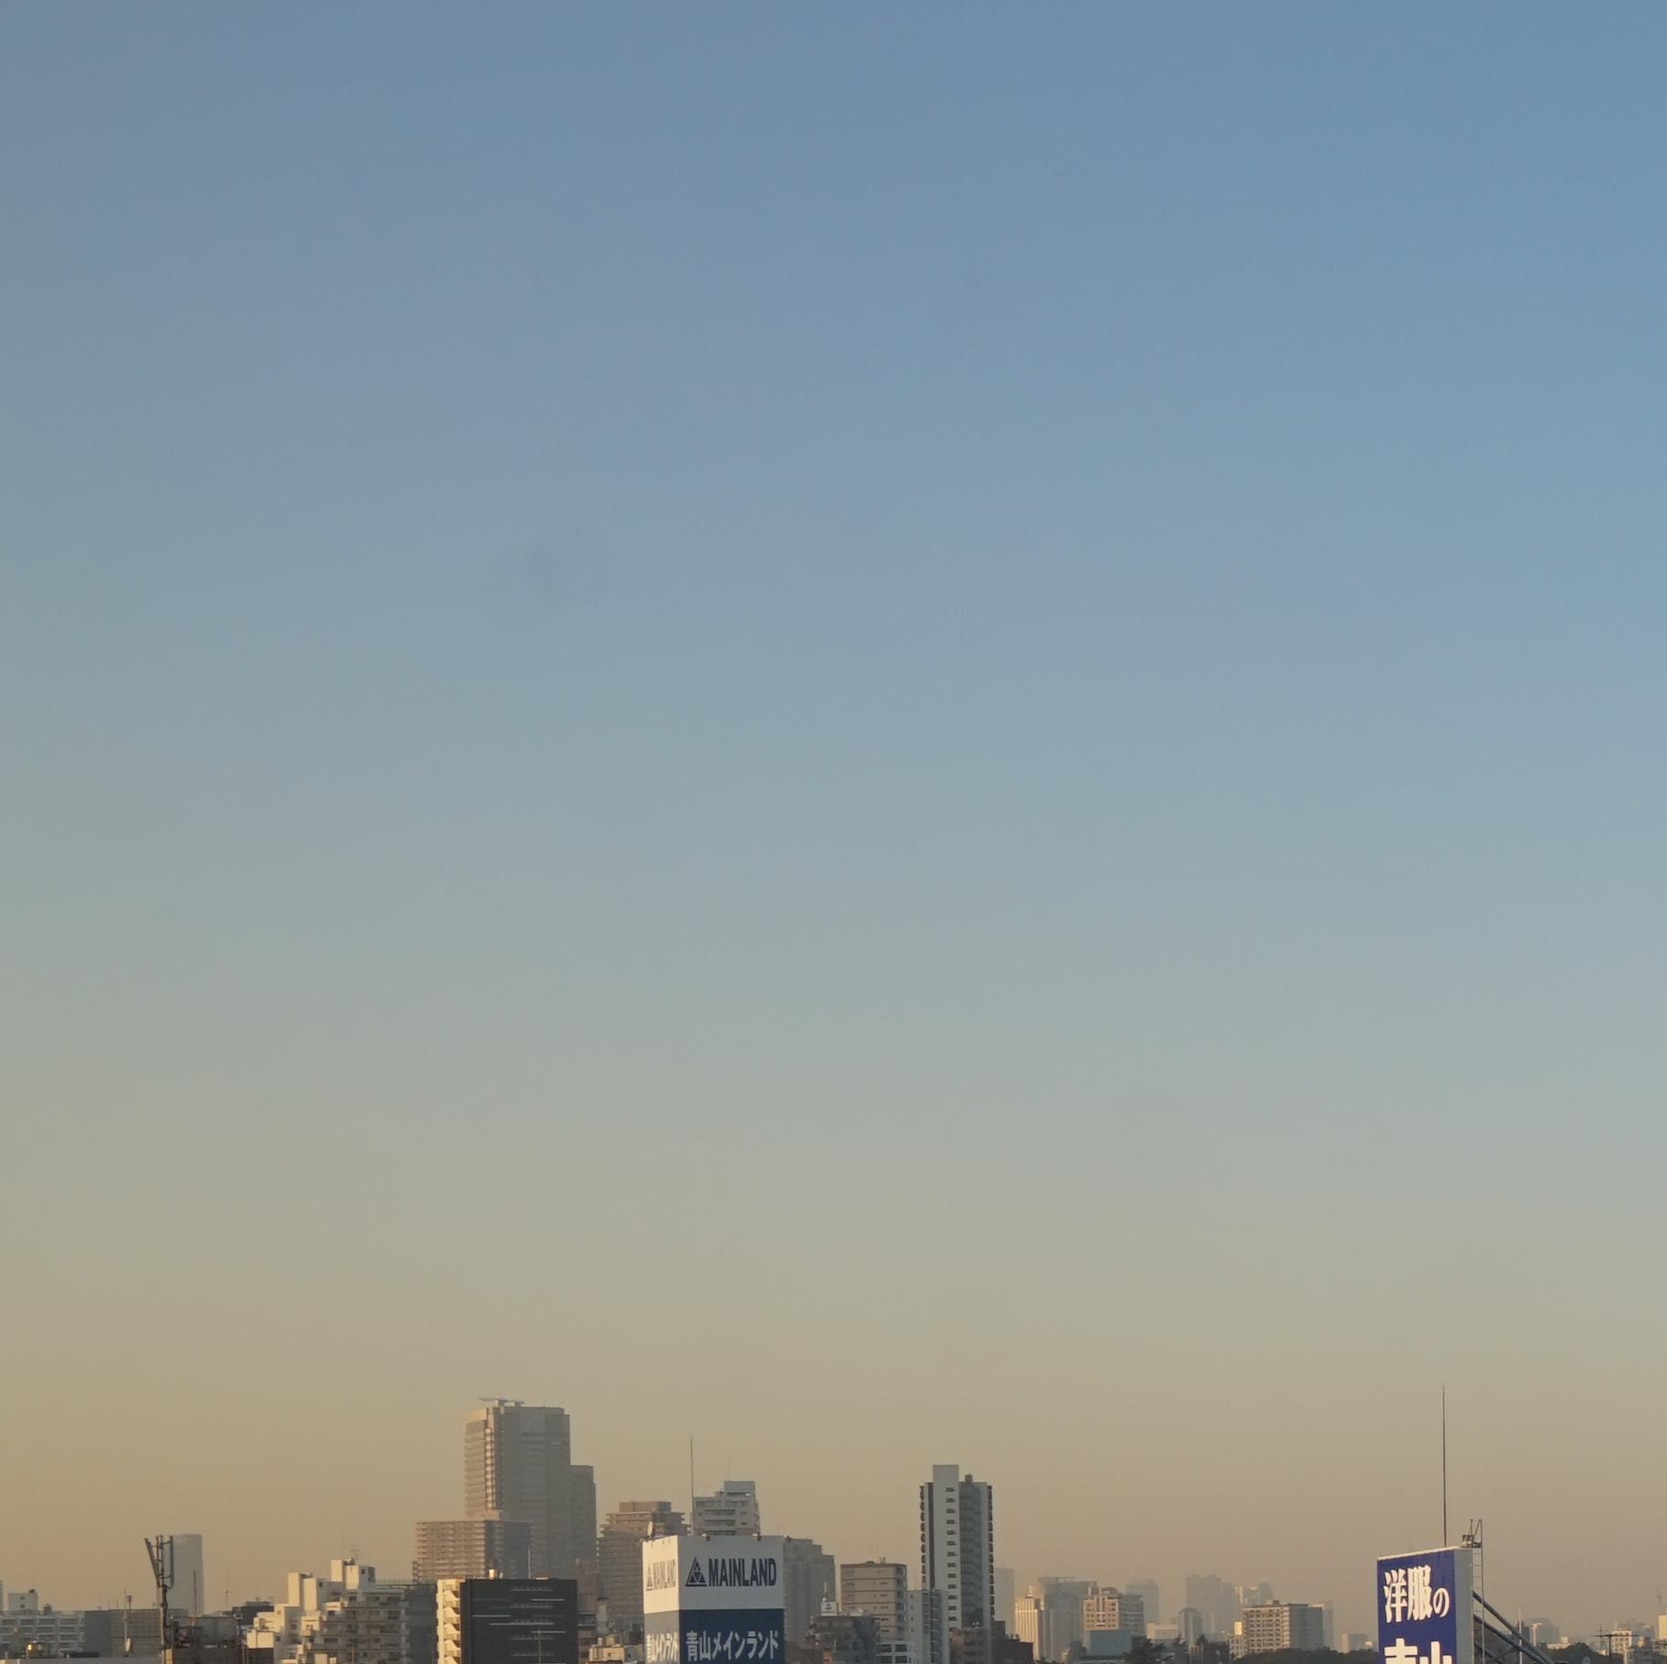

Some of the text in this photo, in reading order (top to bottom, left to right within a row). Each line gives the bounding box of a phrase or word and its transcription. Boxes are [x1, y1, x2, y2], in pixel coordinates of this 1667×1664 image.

[708, 1558, 777, 1588] MAINLAND
[1383, 1564, 1450, 1623] 洋服の
[686, 1630, 779, 1662] 青山メインランド
